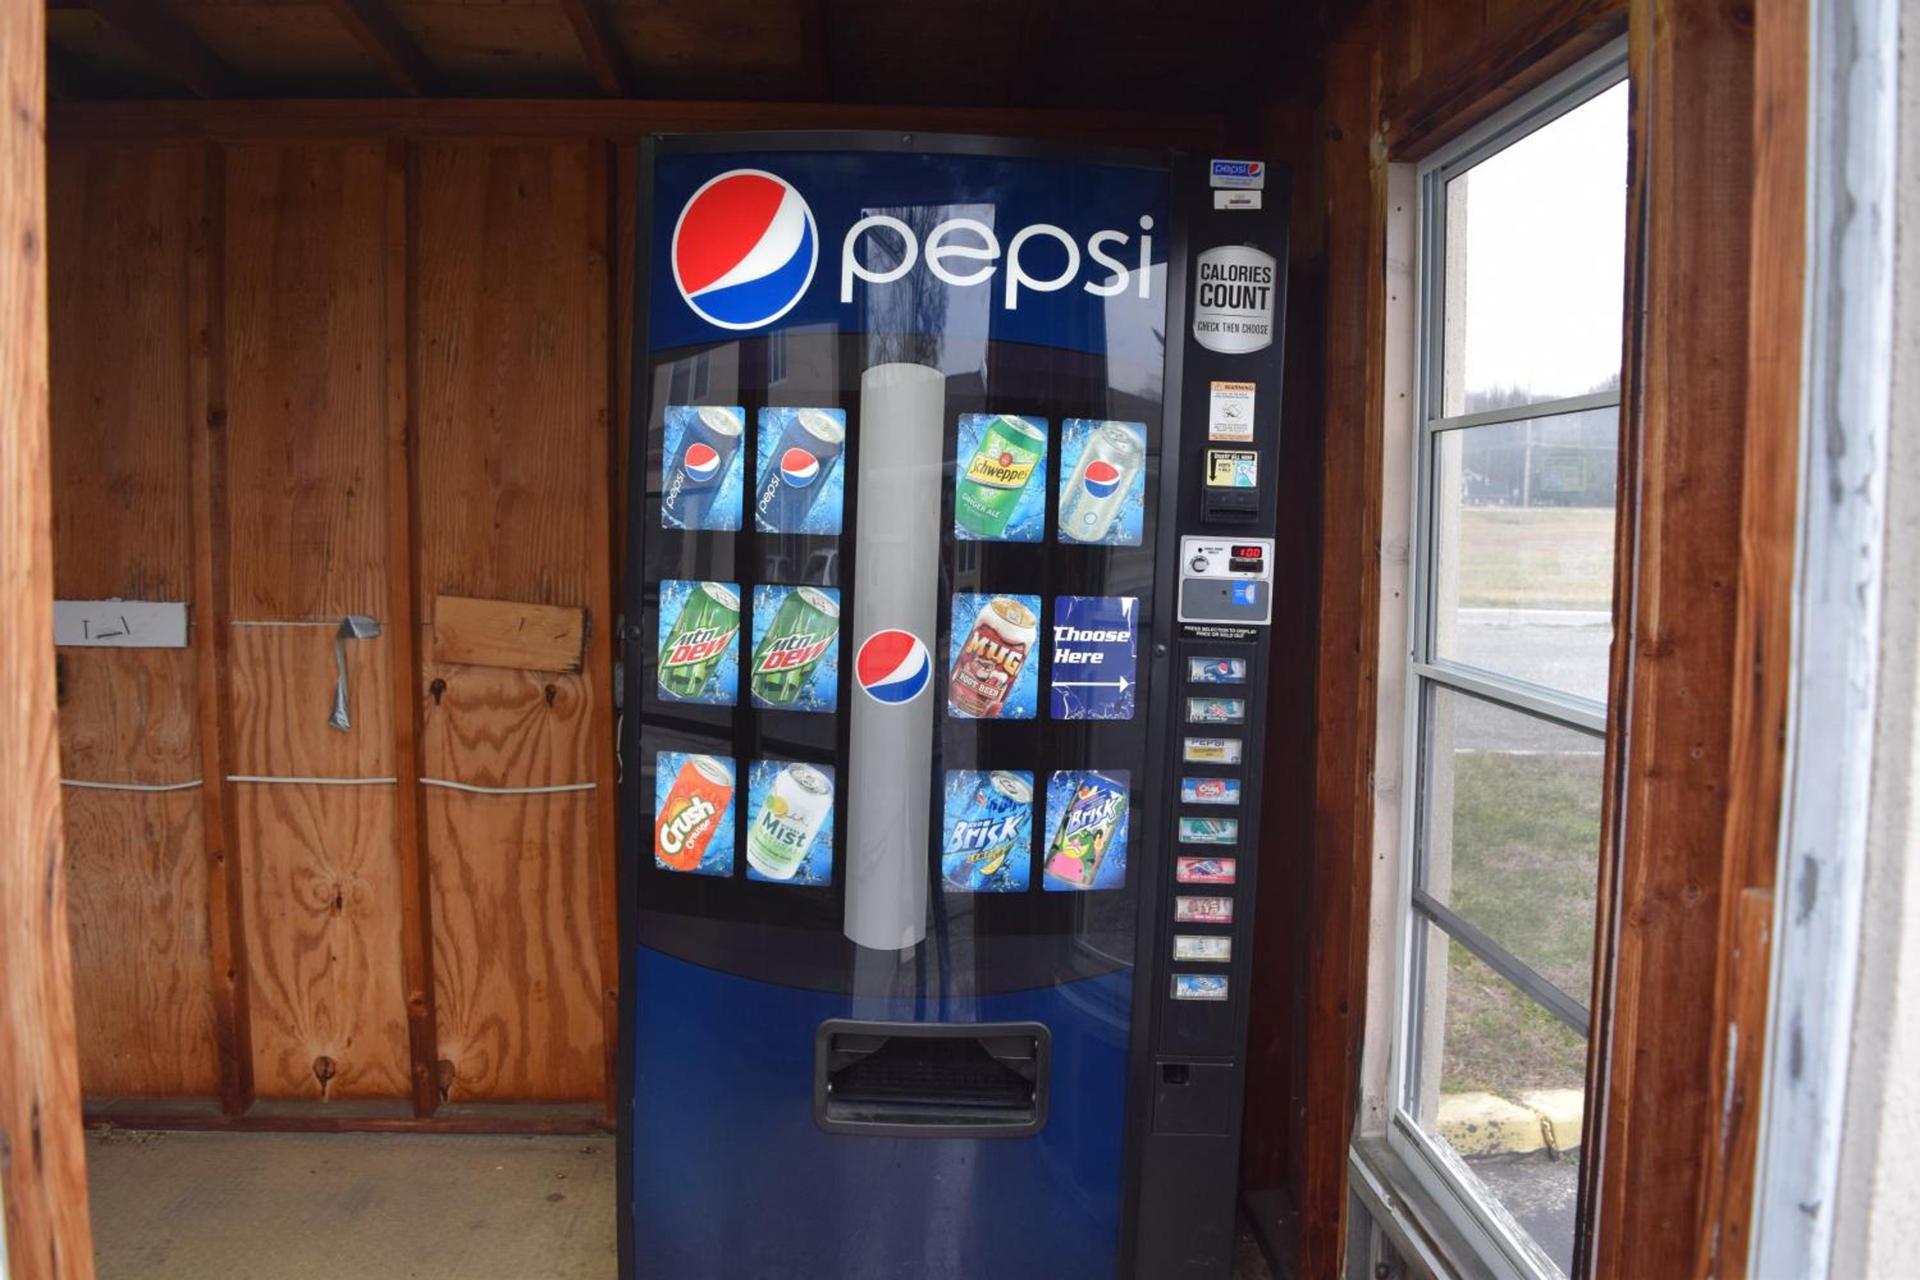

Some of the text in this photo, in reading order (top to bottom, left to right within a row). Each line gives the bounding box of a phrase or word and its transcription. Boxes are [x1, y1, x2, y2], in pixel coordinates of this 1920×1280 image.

[1215, 163, 1247, 176] pepsi
[840, 214, 1154, 310] pepsi
[1200, 263, 1272, 284] CALORIES
[1200, 283, 1271, 311] COUNT
[1197, 321, 1268, 335] CHECK THEN CHOOSE
[665, 469, 686, 510] pepsi
[758, 473, 781, 514] pepsi
[1054, 626, 1131, 642] Choose
[966, 632, 1023, 676] MUG
[1054, 648, 1104, 664] Here
[660, 796, 716, 853] Crush
[762, 811, 806, 848] Mist
